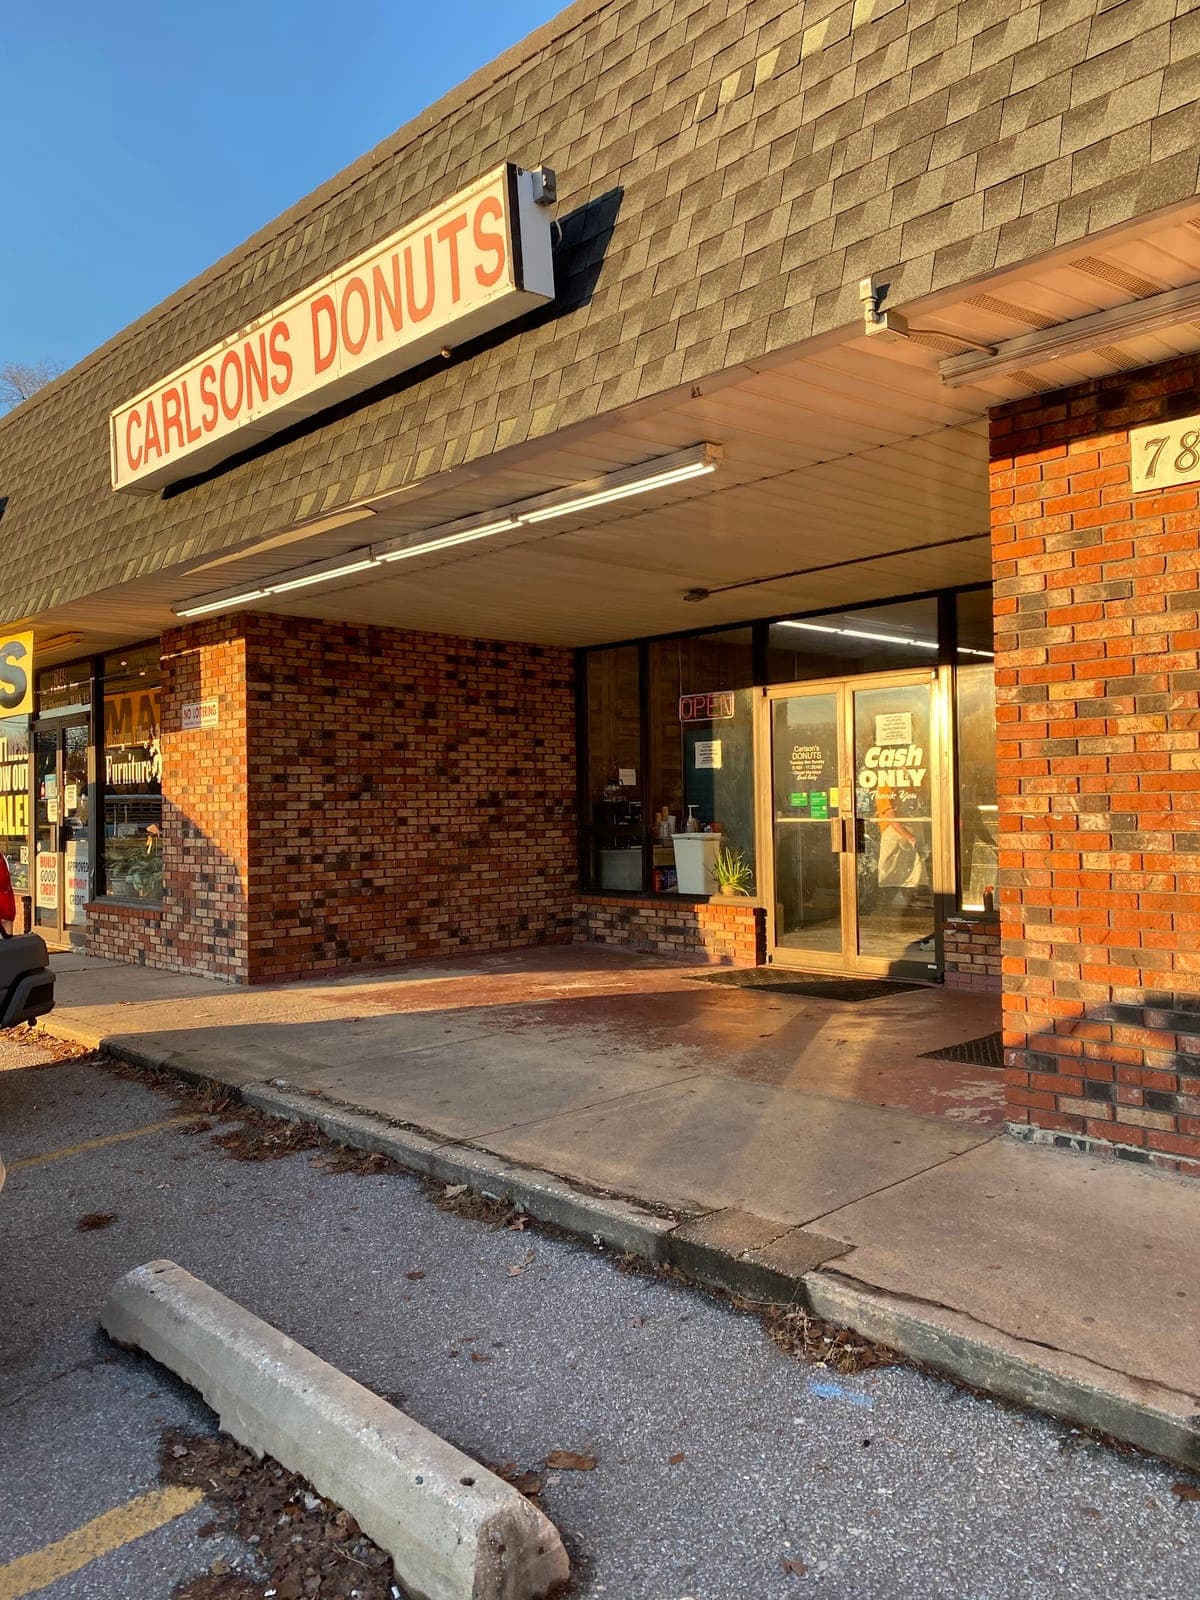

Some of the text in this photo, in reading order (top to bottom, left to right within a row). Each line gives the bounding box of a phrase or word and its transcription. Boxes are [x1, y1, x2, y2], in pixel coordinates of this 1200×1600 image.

[126, 196, 506, 471] CARLSONS DONUTS
[0, 641, 27, 709] S
[682, 694, 732, 719] OPEN
[104, 692, 160, 735] MA
[183, 708, 191, 720] NO
[793, 745, 820, 753] Carlson's
[792, 752, 822, 760] DONUTS
[864, 744, 924, 768] Cash
[105, 752, 152, 785] Furniture
[12, 763, 28, 791] OUT
[859, 768, 927, 788] ONLY
[870, 789, 917, 802] Thank You
[40, 856, 57, 868] BUILD
[67, 861, 89, 873] APPROVED
[40, 870, 57, 882] GOOD
[40, 883, 57, 896] CREDIT
[68, 878, 88, 889] WITHOUT
